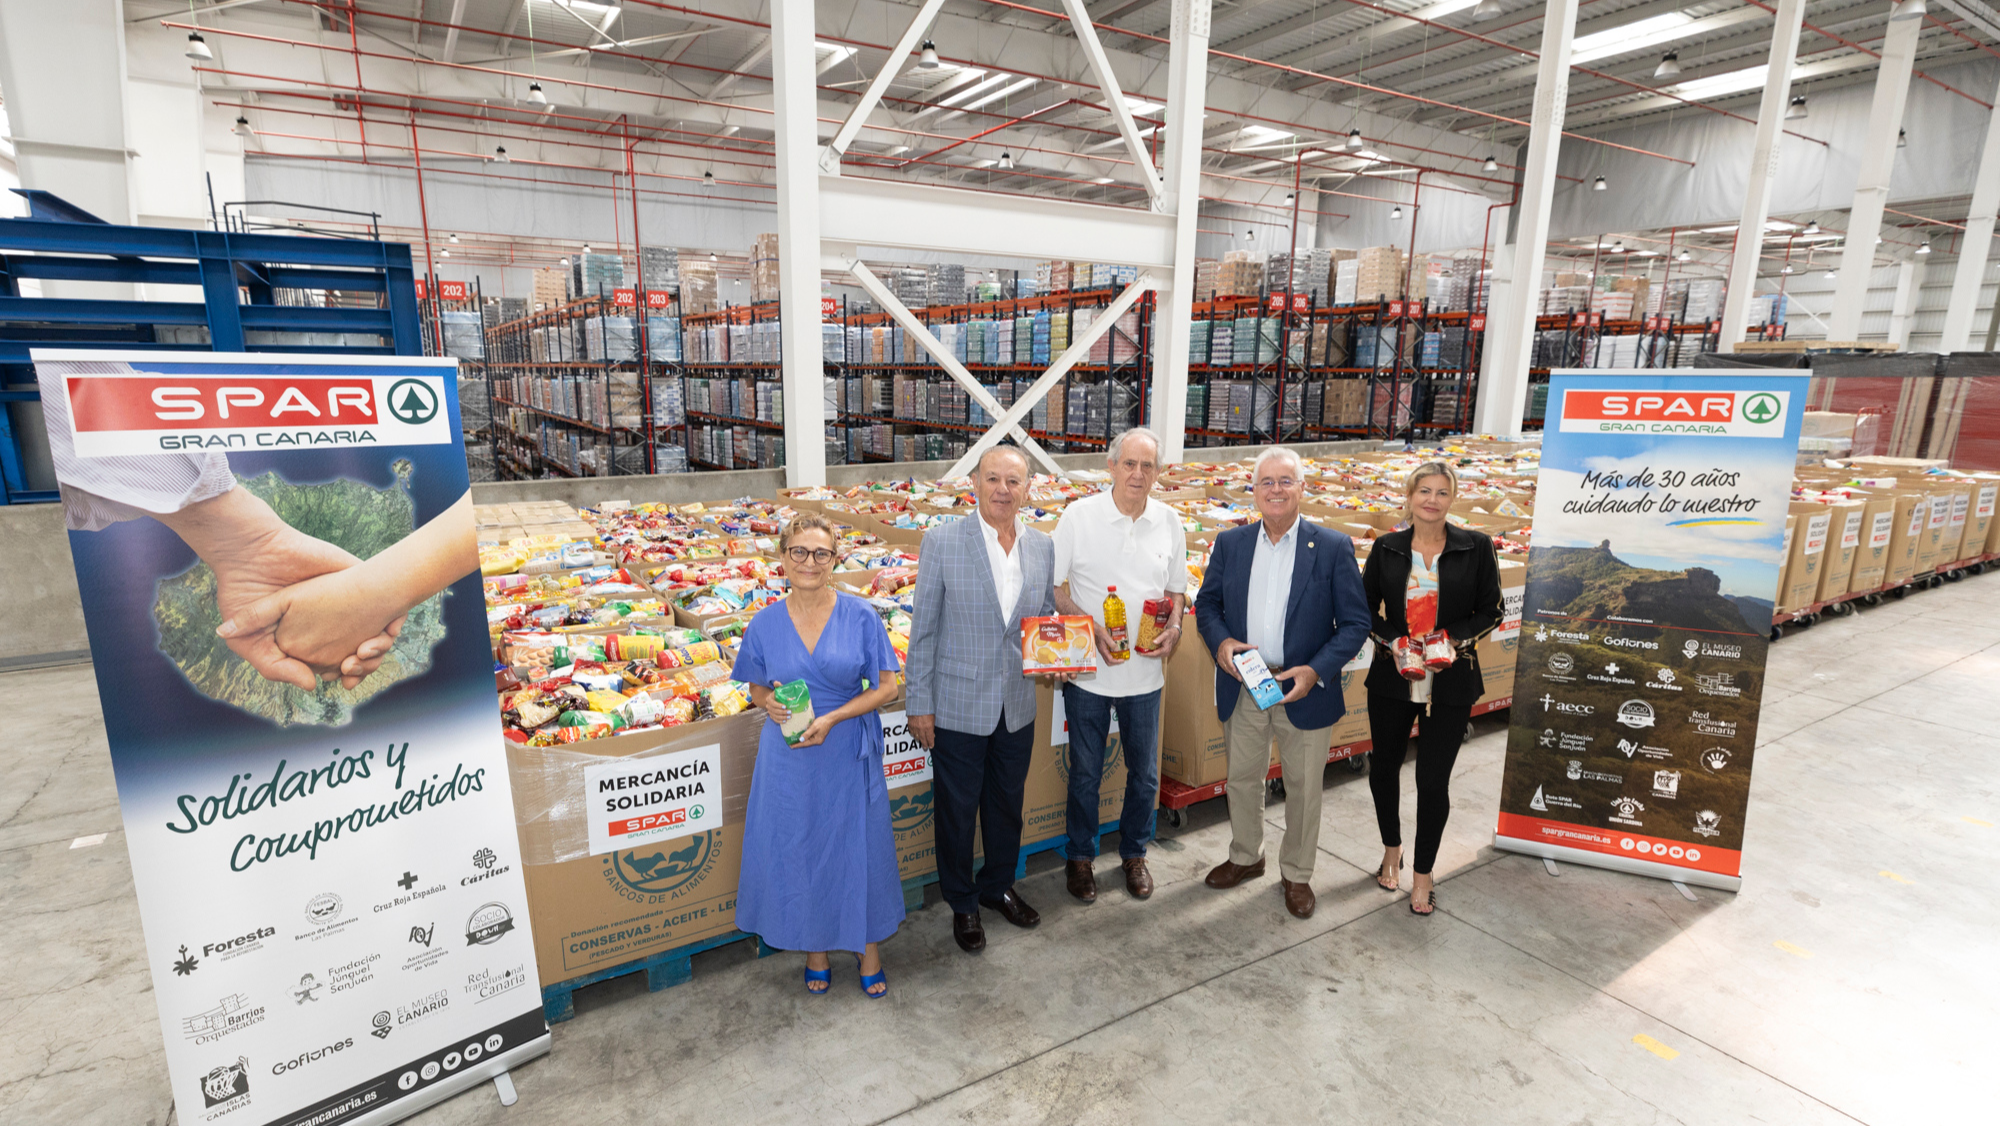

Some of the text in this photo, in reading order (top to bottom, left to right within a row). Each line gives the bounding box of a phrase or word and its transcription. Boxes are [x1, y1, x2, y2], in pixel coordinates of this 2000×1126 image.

[443, 285, 463, 296] 202
[616, 293, 634, 304] 202
[650, 294, 666, 305] 203
[821, 301, 834, 311] 204
[1271, 295, 1284, 307] 205
[1294, 297, 1306, 308] 206
[1410, 304, 1420, 314] 207
[1472, 319, 1484, 328] 207
[151, 386, 373, 421] SPAR
[1602, 396, 1731, 417] SPAR
[1600, 422, 1727, 434] GRAN CANARIA
[160, 429, 377, 450] GRAN CANARIA
[1581, 467, 1740, 490] Más de 30 años
[1563, 492, 1760, 515] cuidando lo nuestro
[1504, 621, 1521, 630] SPA
[1550, 629, 1589, 640] Foresta
[1701, 649, 1741, 659] CANARIO
[1702, 642, 1741, 652] EL MUSEO
[1645, 681, 1683, 691] Cáritas
[1718, 685, 1741, 693] Barrios
[1488, 697, 1512, 711] SPAR
[1556, 702, 1595, 714] aecc
[1626, 704, 1648, 713] SOCIO
[1692, 710, 1710, 719] Red
[1698, 724, 1736, 736] Canaria
[1327, 748, 1351, 761] PAR
[884, 759, 925, 775] SPAR
[599, 759, 710, 793] MERCANCÍA
[1596, 775, 1623, 784] PALMAS
[166, 742, 409, 834] Solidarios y
[606, 782, 705, 812] SOLIDARIA
[230, 763, 485, 872] Comprometidos
[626, 810, 685, 831] SPAR
[1028, 808, 1067, 826] CONSERV
[627, 823, 685, 839] GRAN CANARIA
[1542, 826, 1611, 845] spargrancanaria.es
[902, 847, 936, 863] ACEITE
[461, 865, 510, 887] Cáritas
[603, 840, 723, 905] BANCOS DE ALIMENTOS
[373, 884, 447, 913] Cruz Roja Española
[474, 909, 502, 925] SOCIO
[570, 909, 664, 938] Donación recomendada
[294, 917, 359, 941] Banco de Alimentos
[323, 927, 345, 938] Palmas
[569, 899, 738, 954] CONSERVAS ACEITE LEC
[203, 926, 276, 957] Foresta
[589, 945, 625, 960] (PESCADO
[633, 931, 672, 947] VERDURAS)
[401, 951, 449, 971] Oportunidades
[407, 946, 443, 963] Asociación
[328, 953, 381, 976] Fundación
[424, 959, 438, 969] Vida
[467, 968, 489, 984] Red
[479, 973, 525, 998] Canaria
[397, 989, 448, 1016] EL MUSEO
[227, 1006, 265, 1026] Barrios
[398, 998, 449, 1025] CANARIO
[195, 1015, 265, 1045] Orquestados
[226, 1093, 250, 1107] ISLAS
[298, 1090, 377, 1126] rancanaria.es
[206, 1099, 252, 1122] CANARIAS
